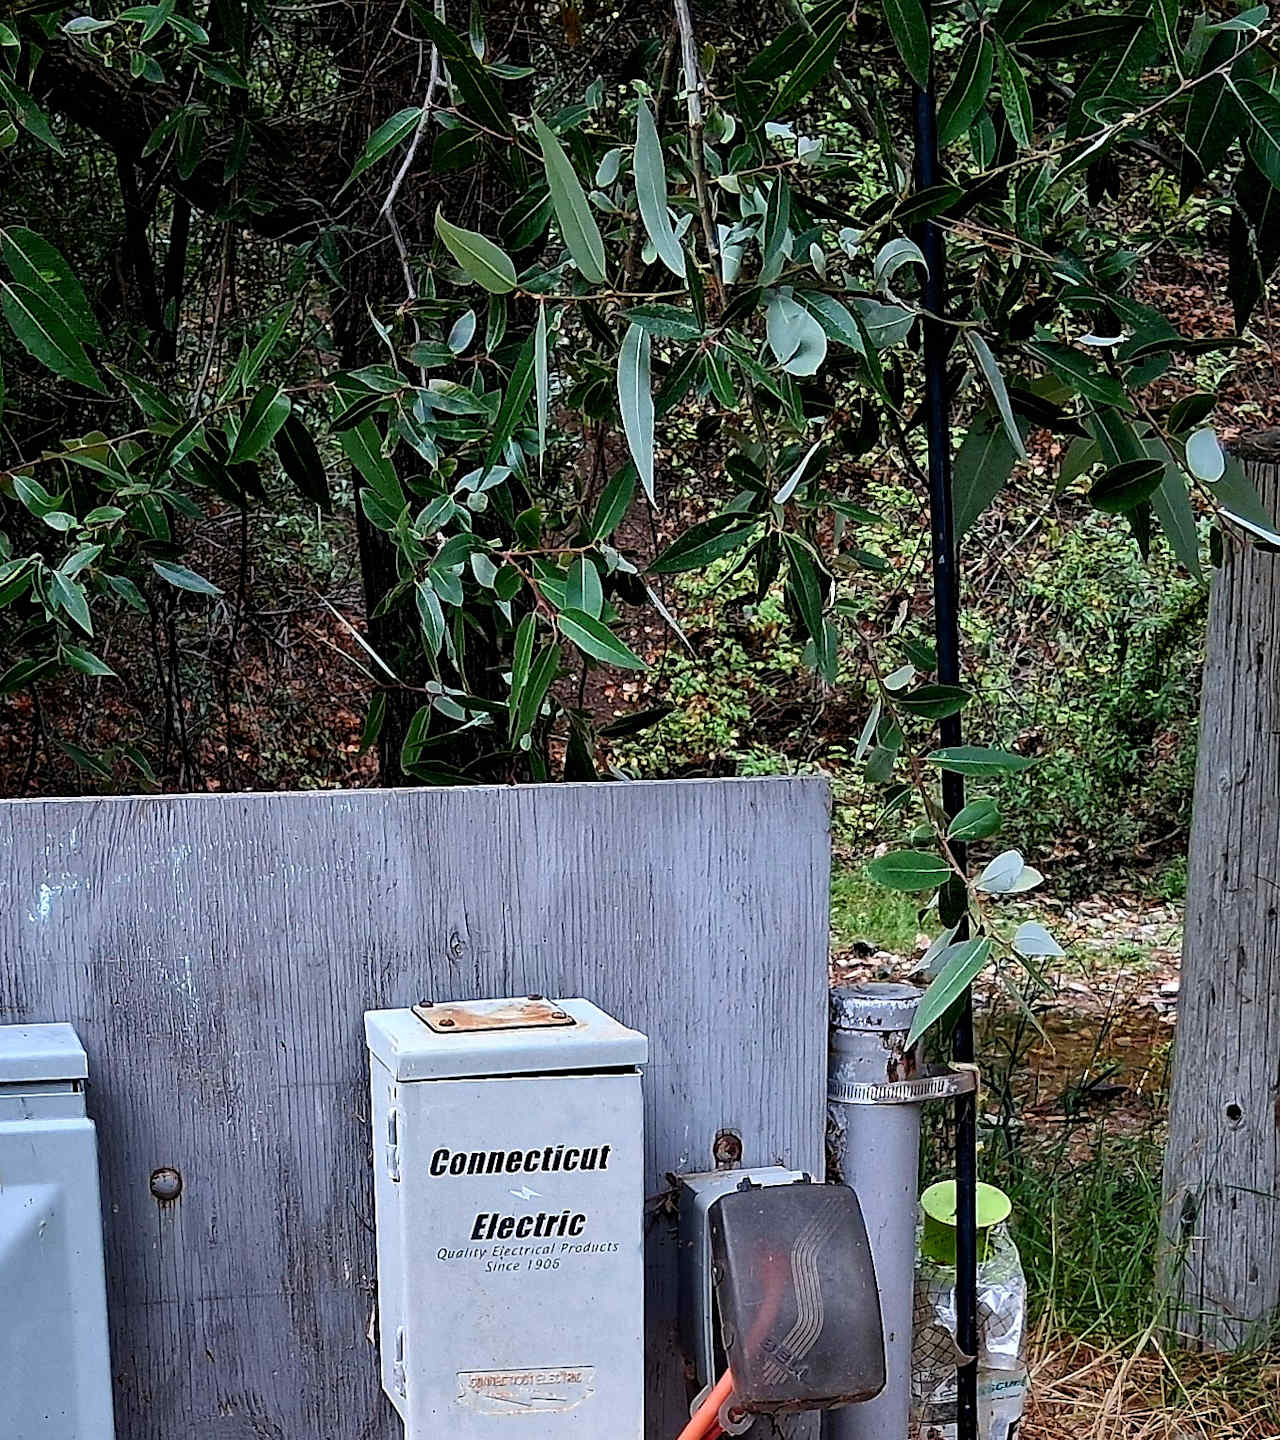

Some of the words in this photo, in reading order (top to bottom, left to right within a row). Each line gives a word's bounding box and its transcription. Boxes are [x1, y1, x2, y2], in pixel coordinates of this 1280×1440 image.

[429, 1144, 611, 1177] Connecticut
[470, 1209, 586, 1241] Electric
[437, 1245, 487, 1261] Quality
[492, 1242, 556, 1258] Electrical
[561, 1240, 620, 1254] Products
[485, 1260, 520, 1273] Since
[527, 1257, 561, 1271] 1906
